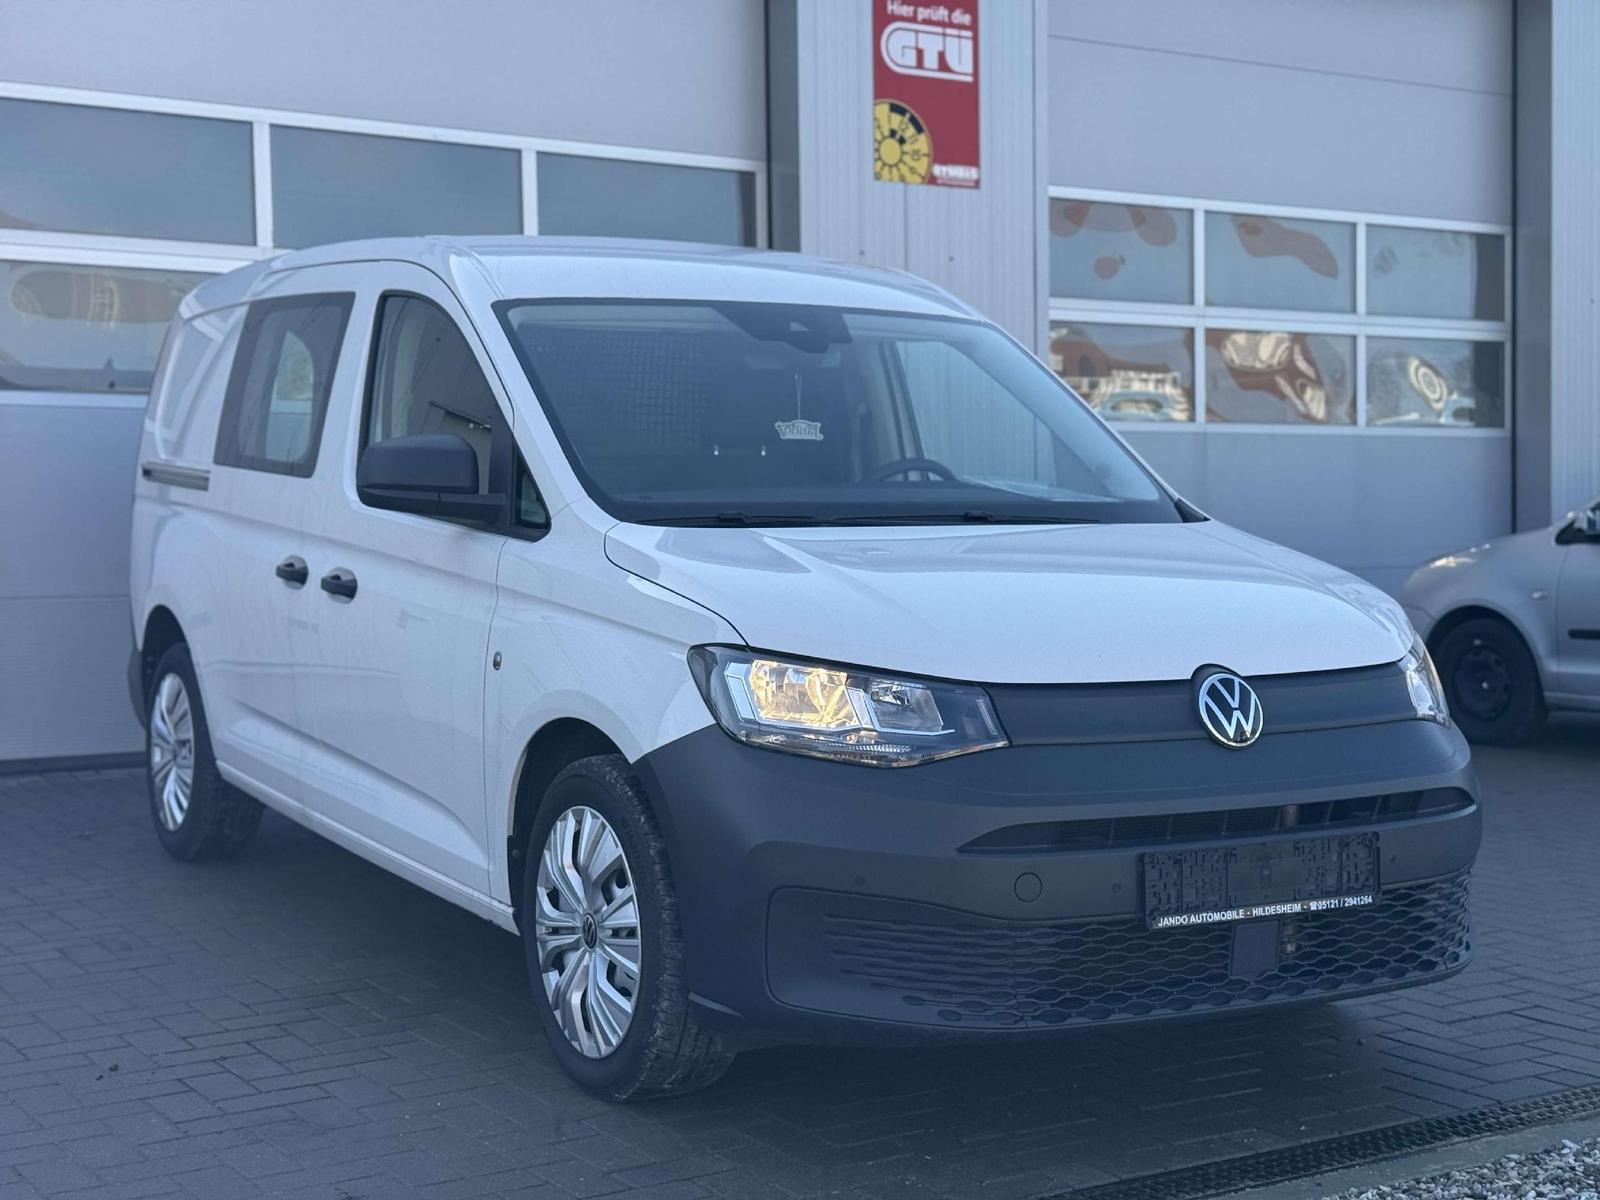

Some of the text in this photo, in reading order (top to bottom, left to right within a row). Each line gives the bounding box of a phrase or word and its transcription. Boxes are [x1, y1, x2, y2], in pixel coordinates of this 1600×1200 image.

[887, 0, 972, 25] Hier prüft die
[881, 22, 973, 80] GTÜ
[1158, 915, 1188, 927] JANDO
[1190, 909, 1245, 924] AUTOMOBILE
[1252, 903, 1302, 917] HILDESHEIM
